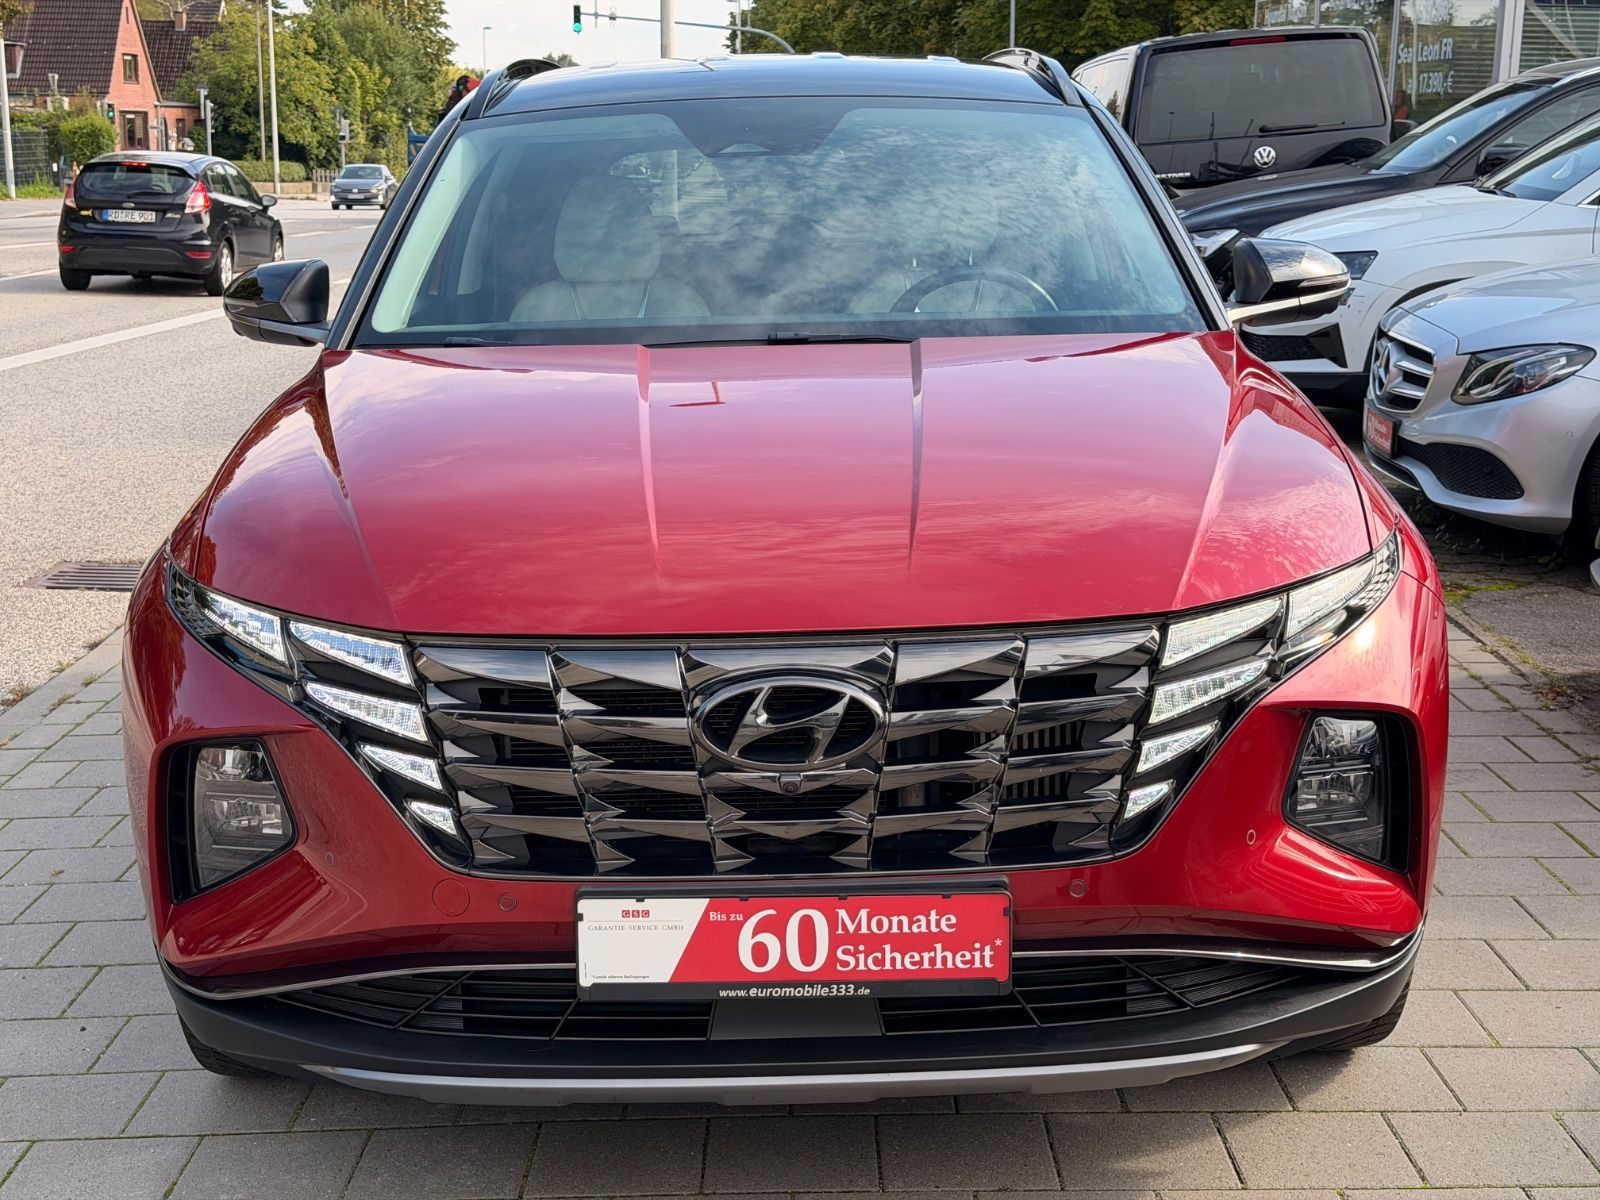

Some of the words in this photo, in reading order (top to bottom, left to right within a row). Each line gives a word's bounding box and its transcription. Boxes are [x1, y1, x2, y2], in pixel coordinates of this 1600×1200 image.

[1418, 42, 1440, 62] Leon
[1440, 37, 1454, 59] FR
[709, 911, 727, 921] Bis
[729, 913, 744, 921] zu
[835, 908, 957, 934] Monate
[737, 908, 829, 973] 60
[719, 984, 870, 998] www.euromobile333.de
